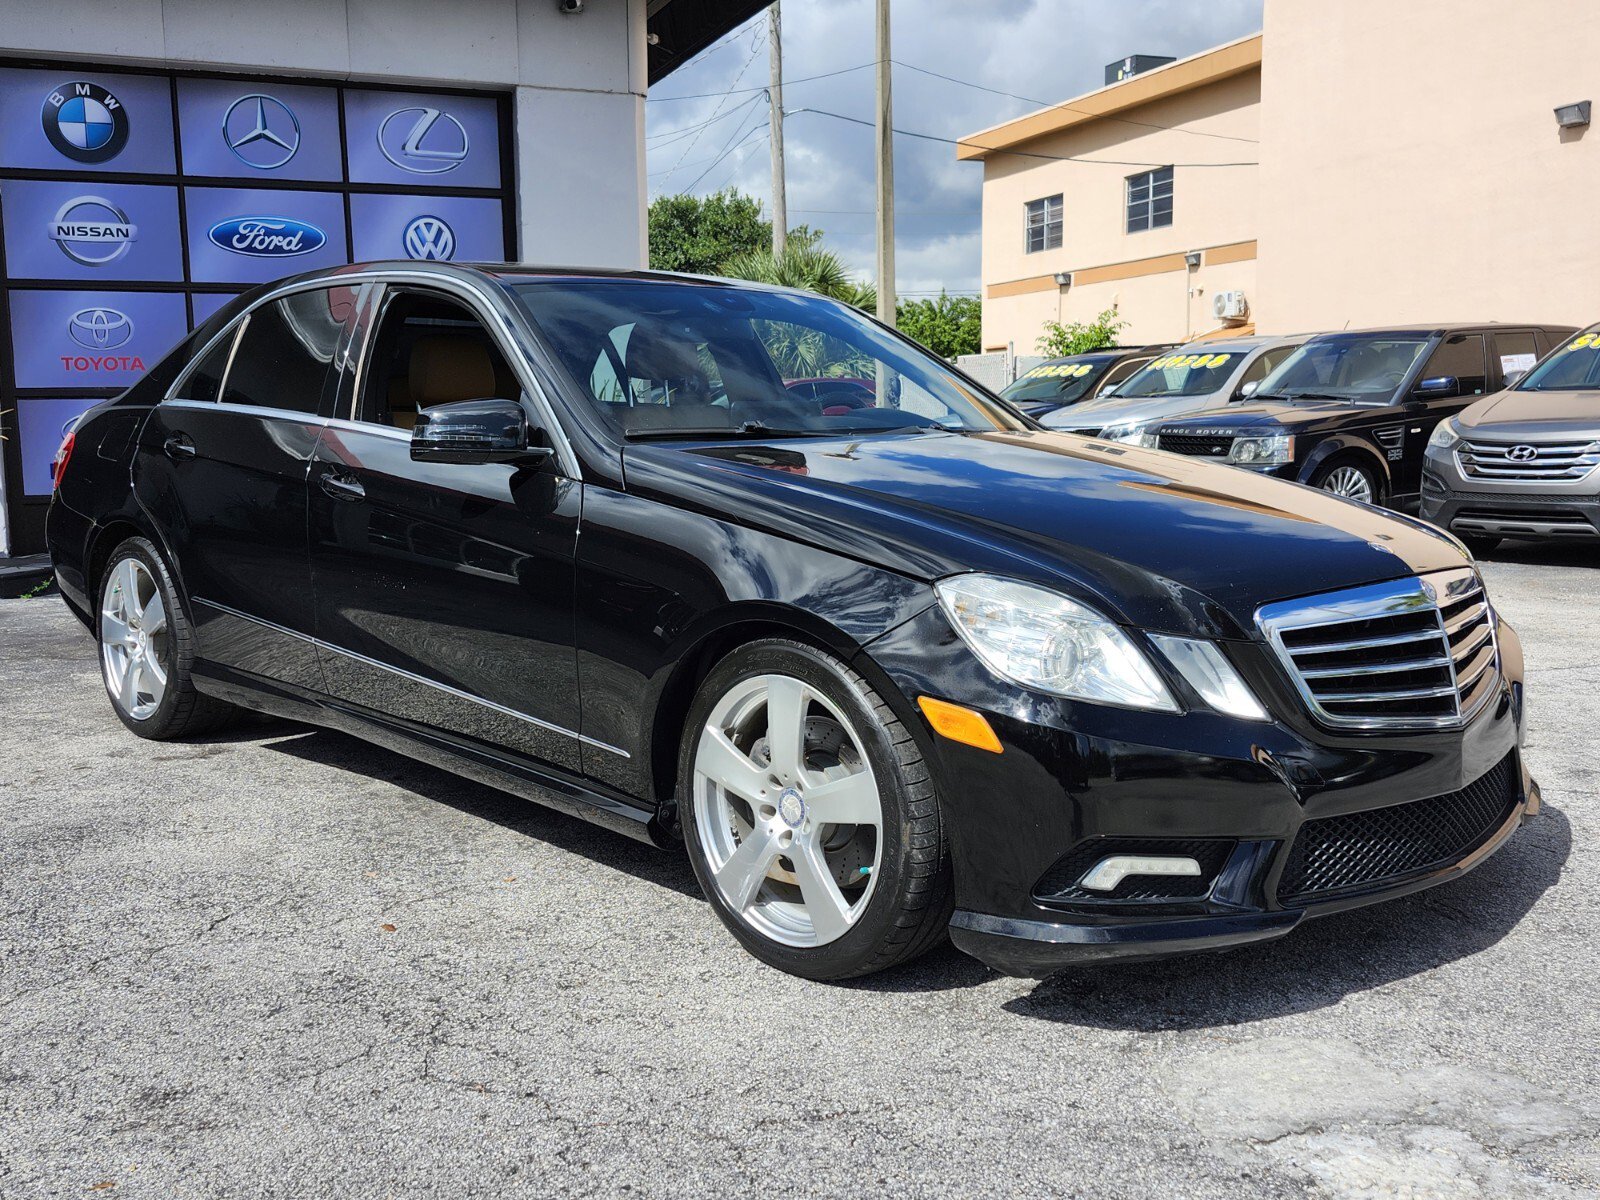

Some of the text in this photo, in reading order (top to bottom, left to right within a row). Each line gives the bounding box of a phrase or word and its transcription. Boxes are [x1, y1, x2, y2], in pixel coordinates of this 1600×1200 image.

[48, 83, 120, 110] BMW
[57, 226, 130, 238] NISSAN
[232, 221, 304, 251] Ford
[61, 356, 146, 371] TOYOTA
